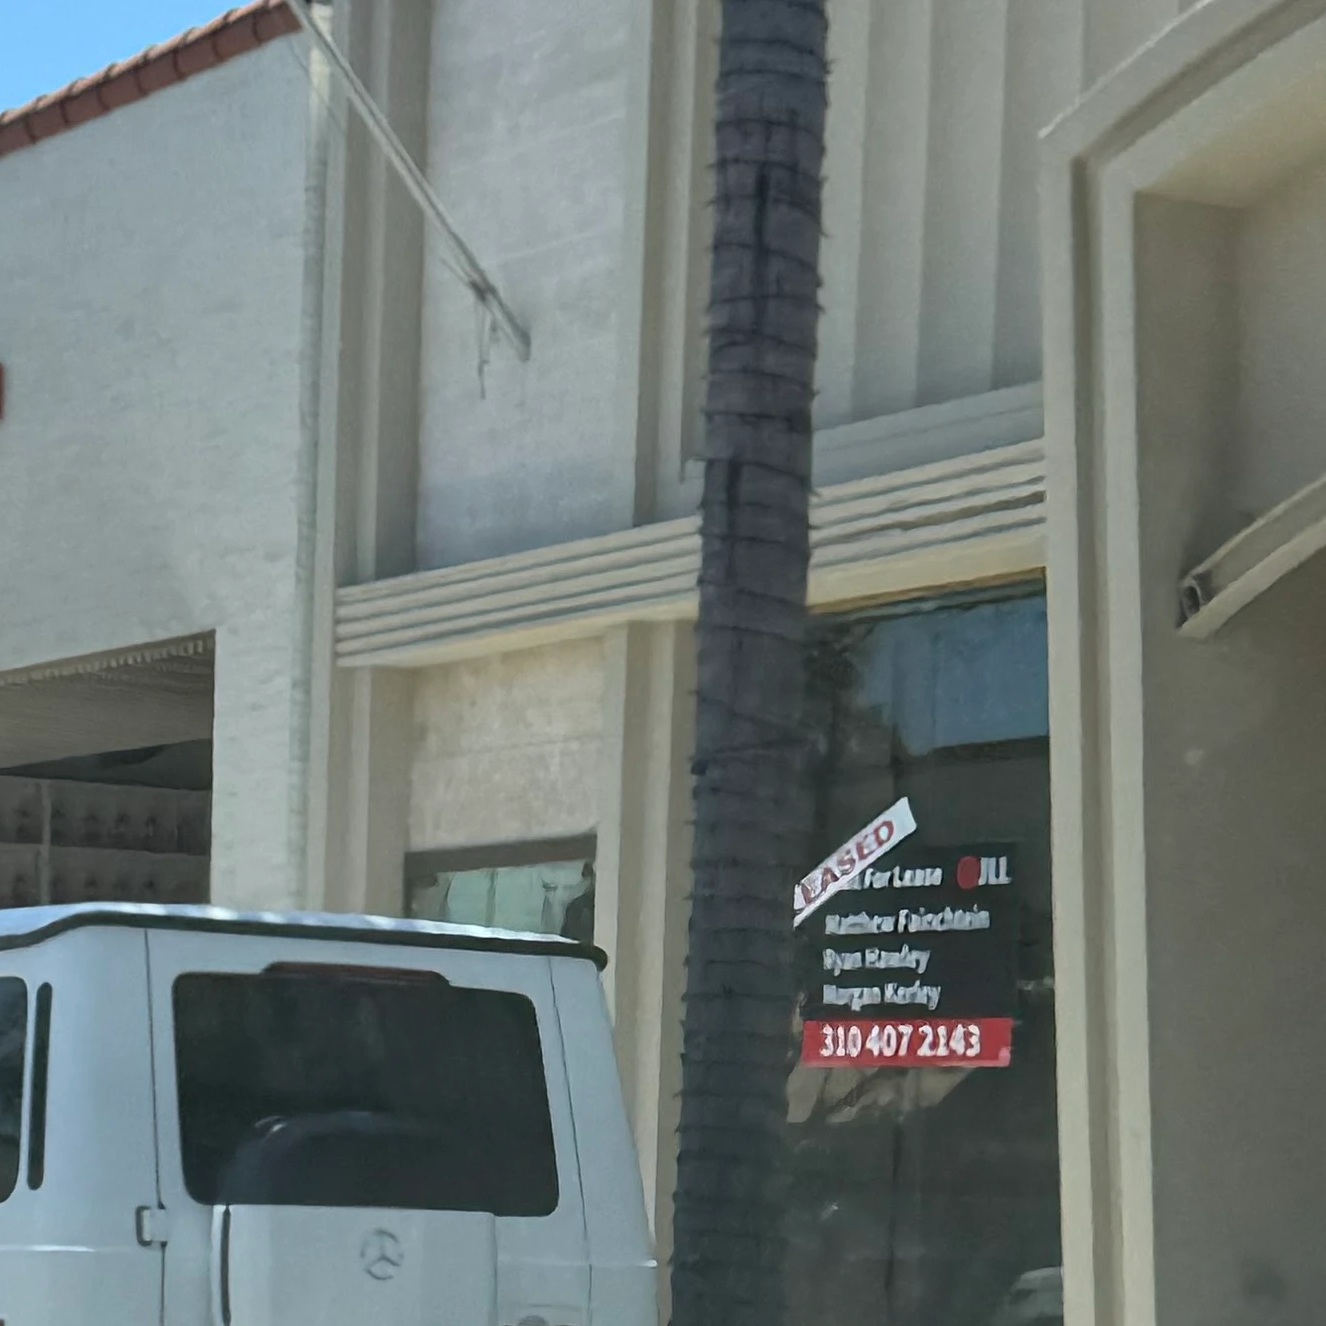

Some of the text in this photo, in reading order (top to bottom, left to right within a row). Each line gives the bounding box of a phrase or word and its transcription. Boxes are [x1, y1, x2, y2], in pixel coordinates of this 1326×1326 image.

[819, 1022, 981, 1057] 310 407 2143
